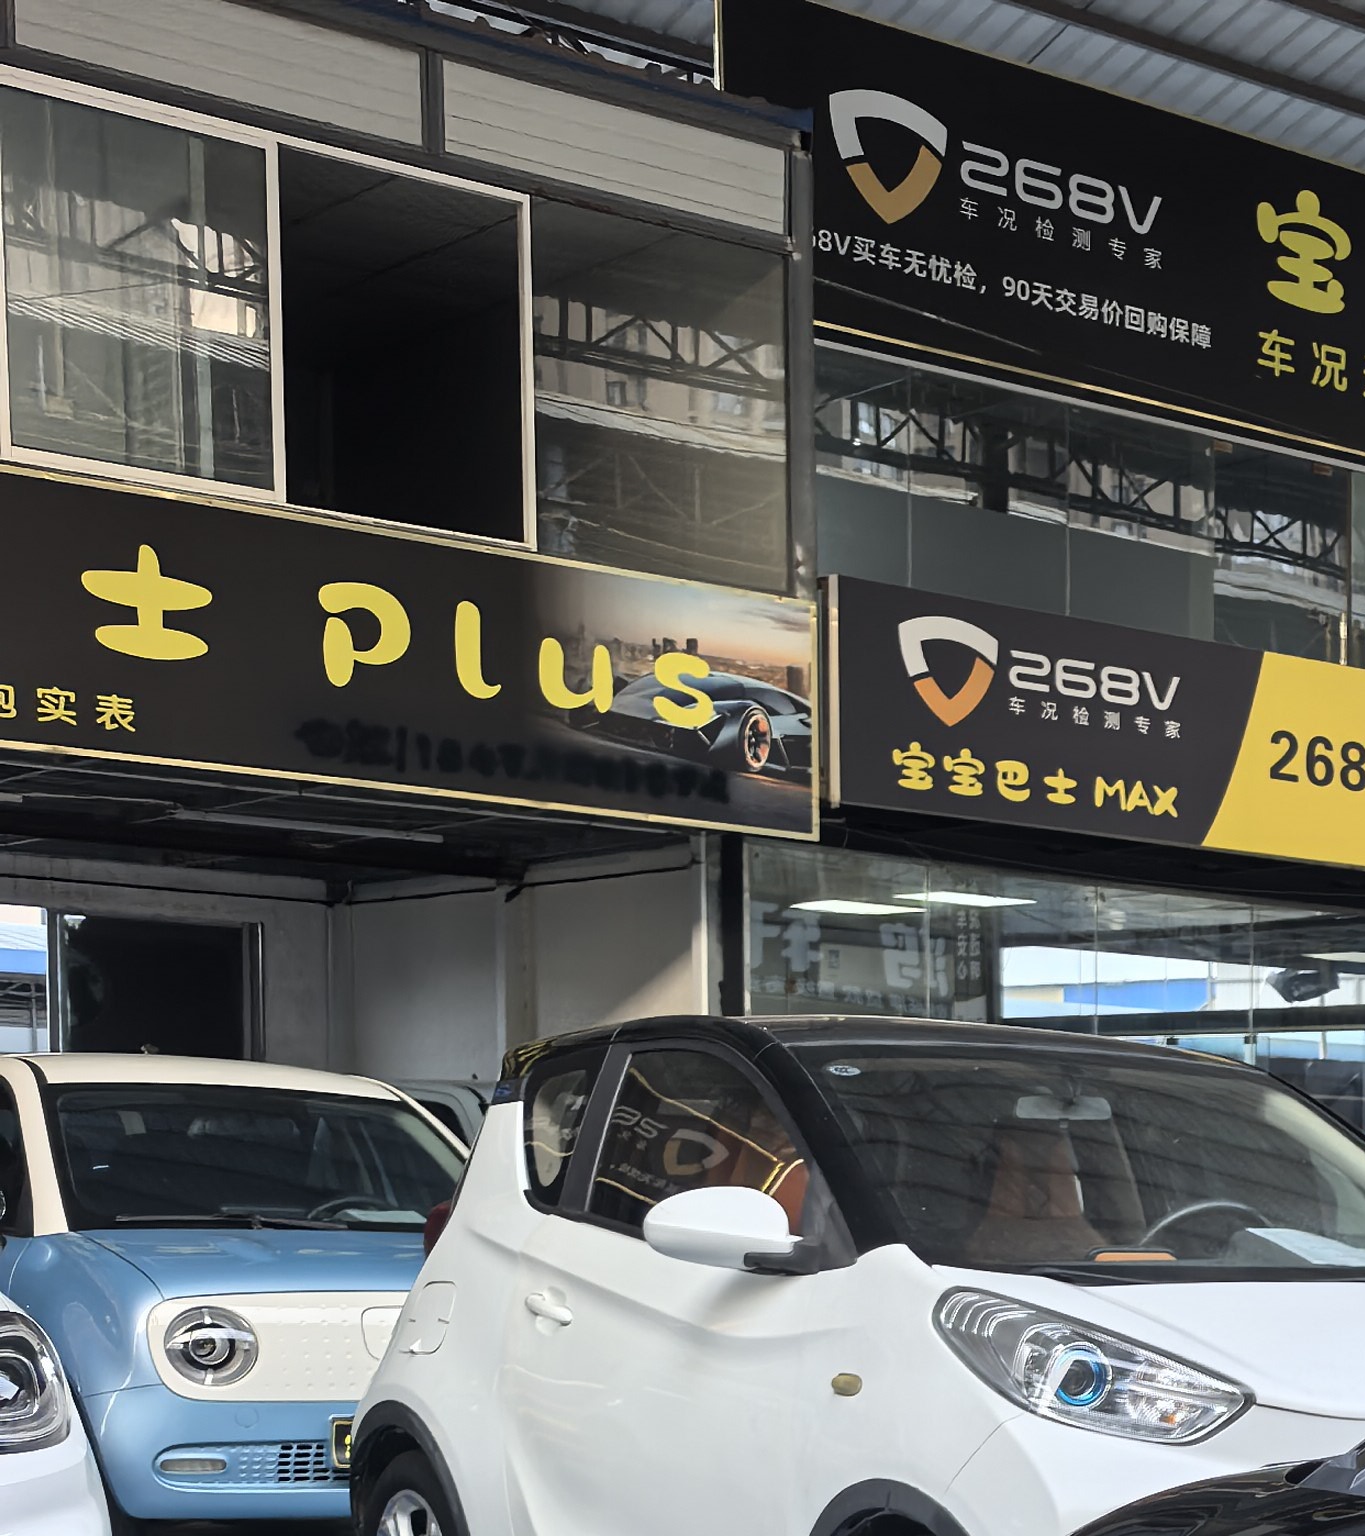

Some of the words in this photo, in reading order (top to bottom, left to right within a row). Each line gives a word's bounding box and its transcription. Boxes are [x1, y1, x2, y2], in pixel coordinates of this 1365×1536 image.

[960, 141, 1163, 235] 268V
[959, 198, 1164, 271] 车况检测专家
[80, 544, 213, 661] 士
[317, 581, 716, 728] Plus
[1009, 650, 1181, 711] 268V
[1009, 696, 1182, 740] 车况检测专家
[892, 741, 1078, 805] 宝宝巴士
[1094, 775, 1179, 819] MAX
